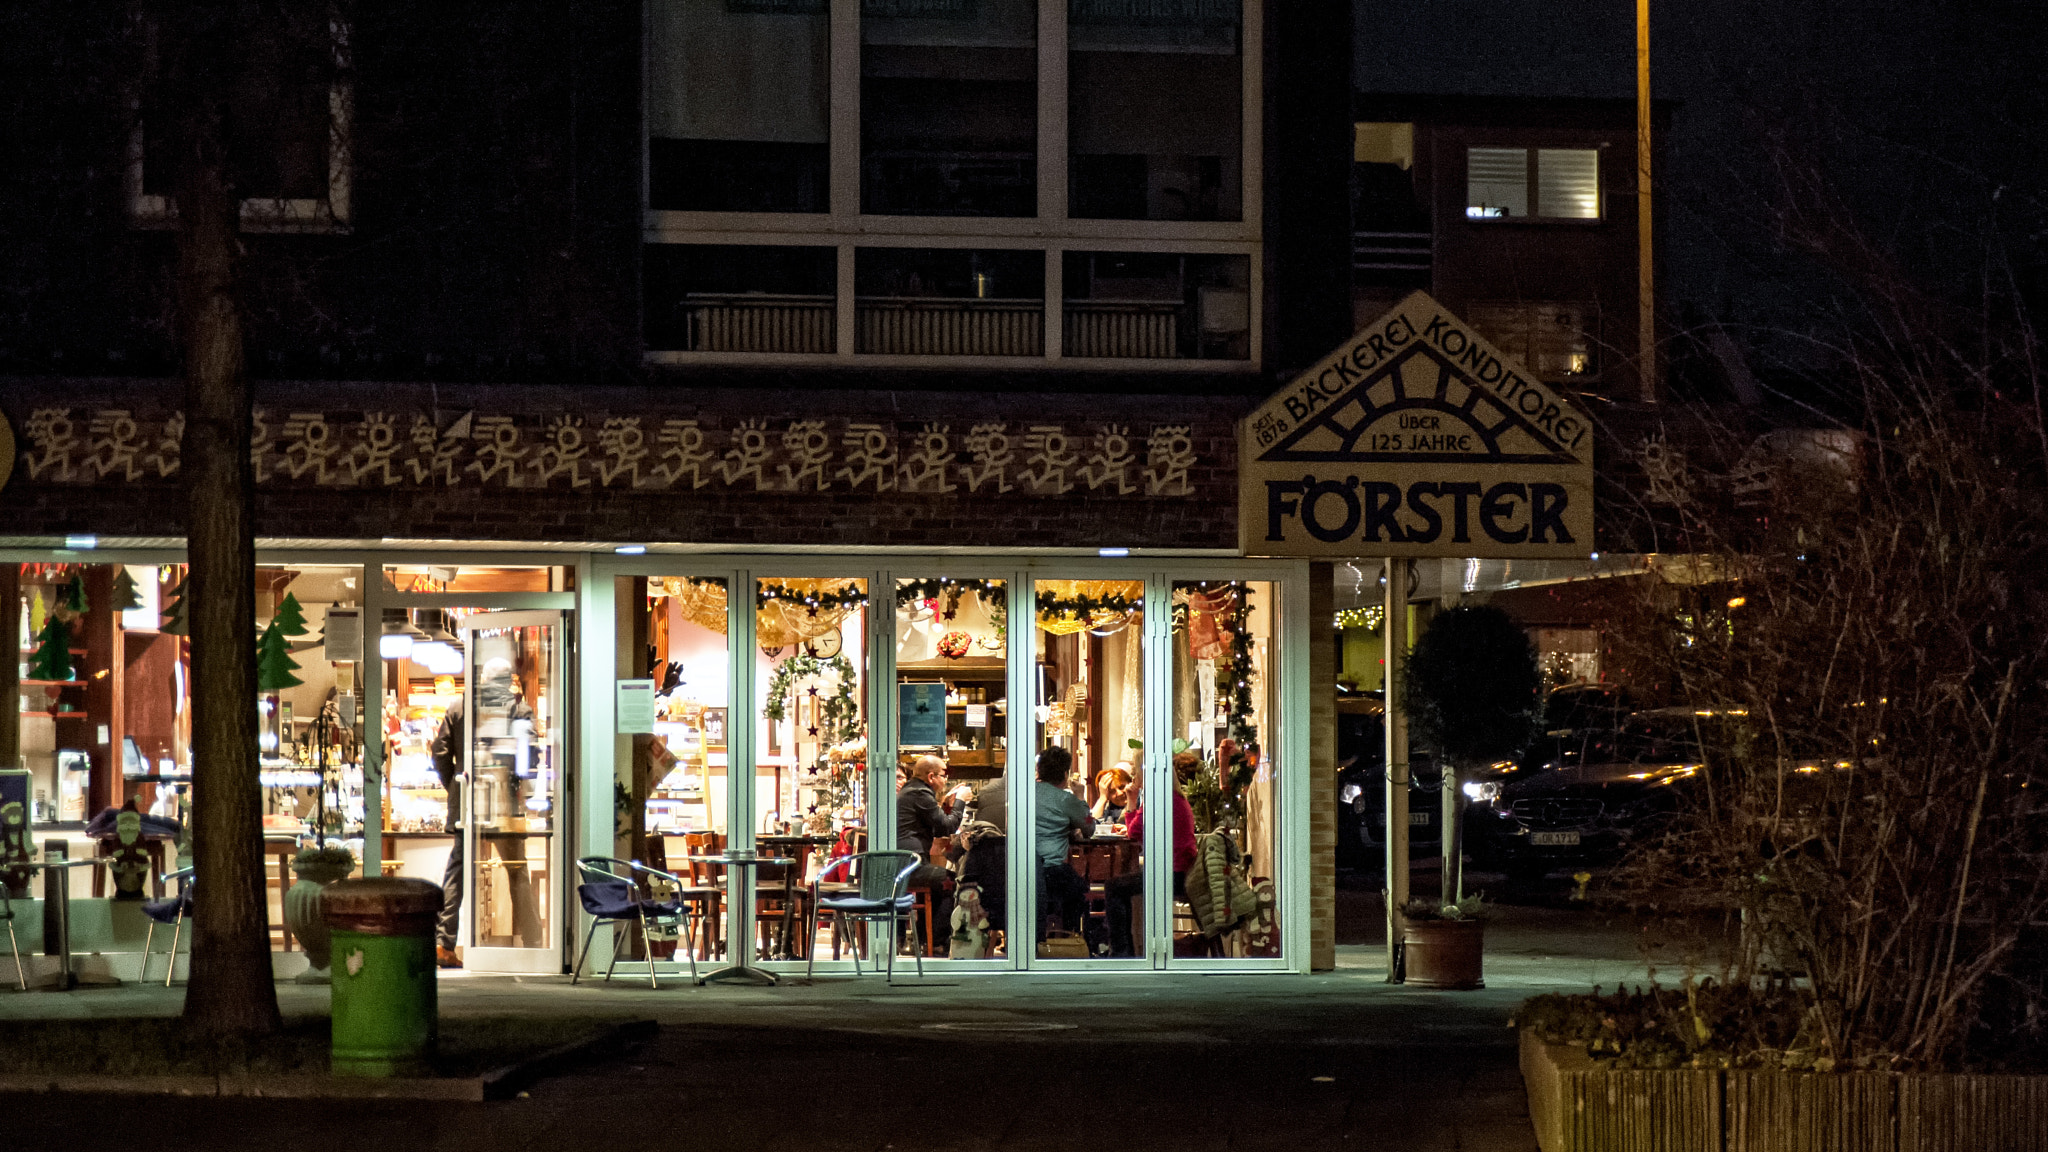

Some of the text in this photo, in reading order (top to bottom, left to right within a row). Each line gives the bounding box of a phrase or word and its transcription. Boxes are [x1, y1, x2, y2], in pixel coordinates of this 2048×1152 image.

[1284, 314, 1586, 449] BÄCKEREI KONDITOREI
[1252, 412, 1275, 434] SEIT
[1256, 420, 1288, 448] 1878
[1399, 413, 1440, 430] ÜBER
[1371, 434, 1472, 451] 125 JAHRE
[1264, 474, 1576, 544] FÖRSTER
